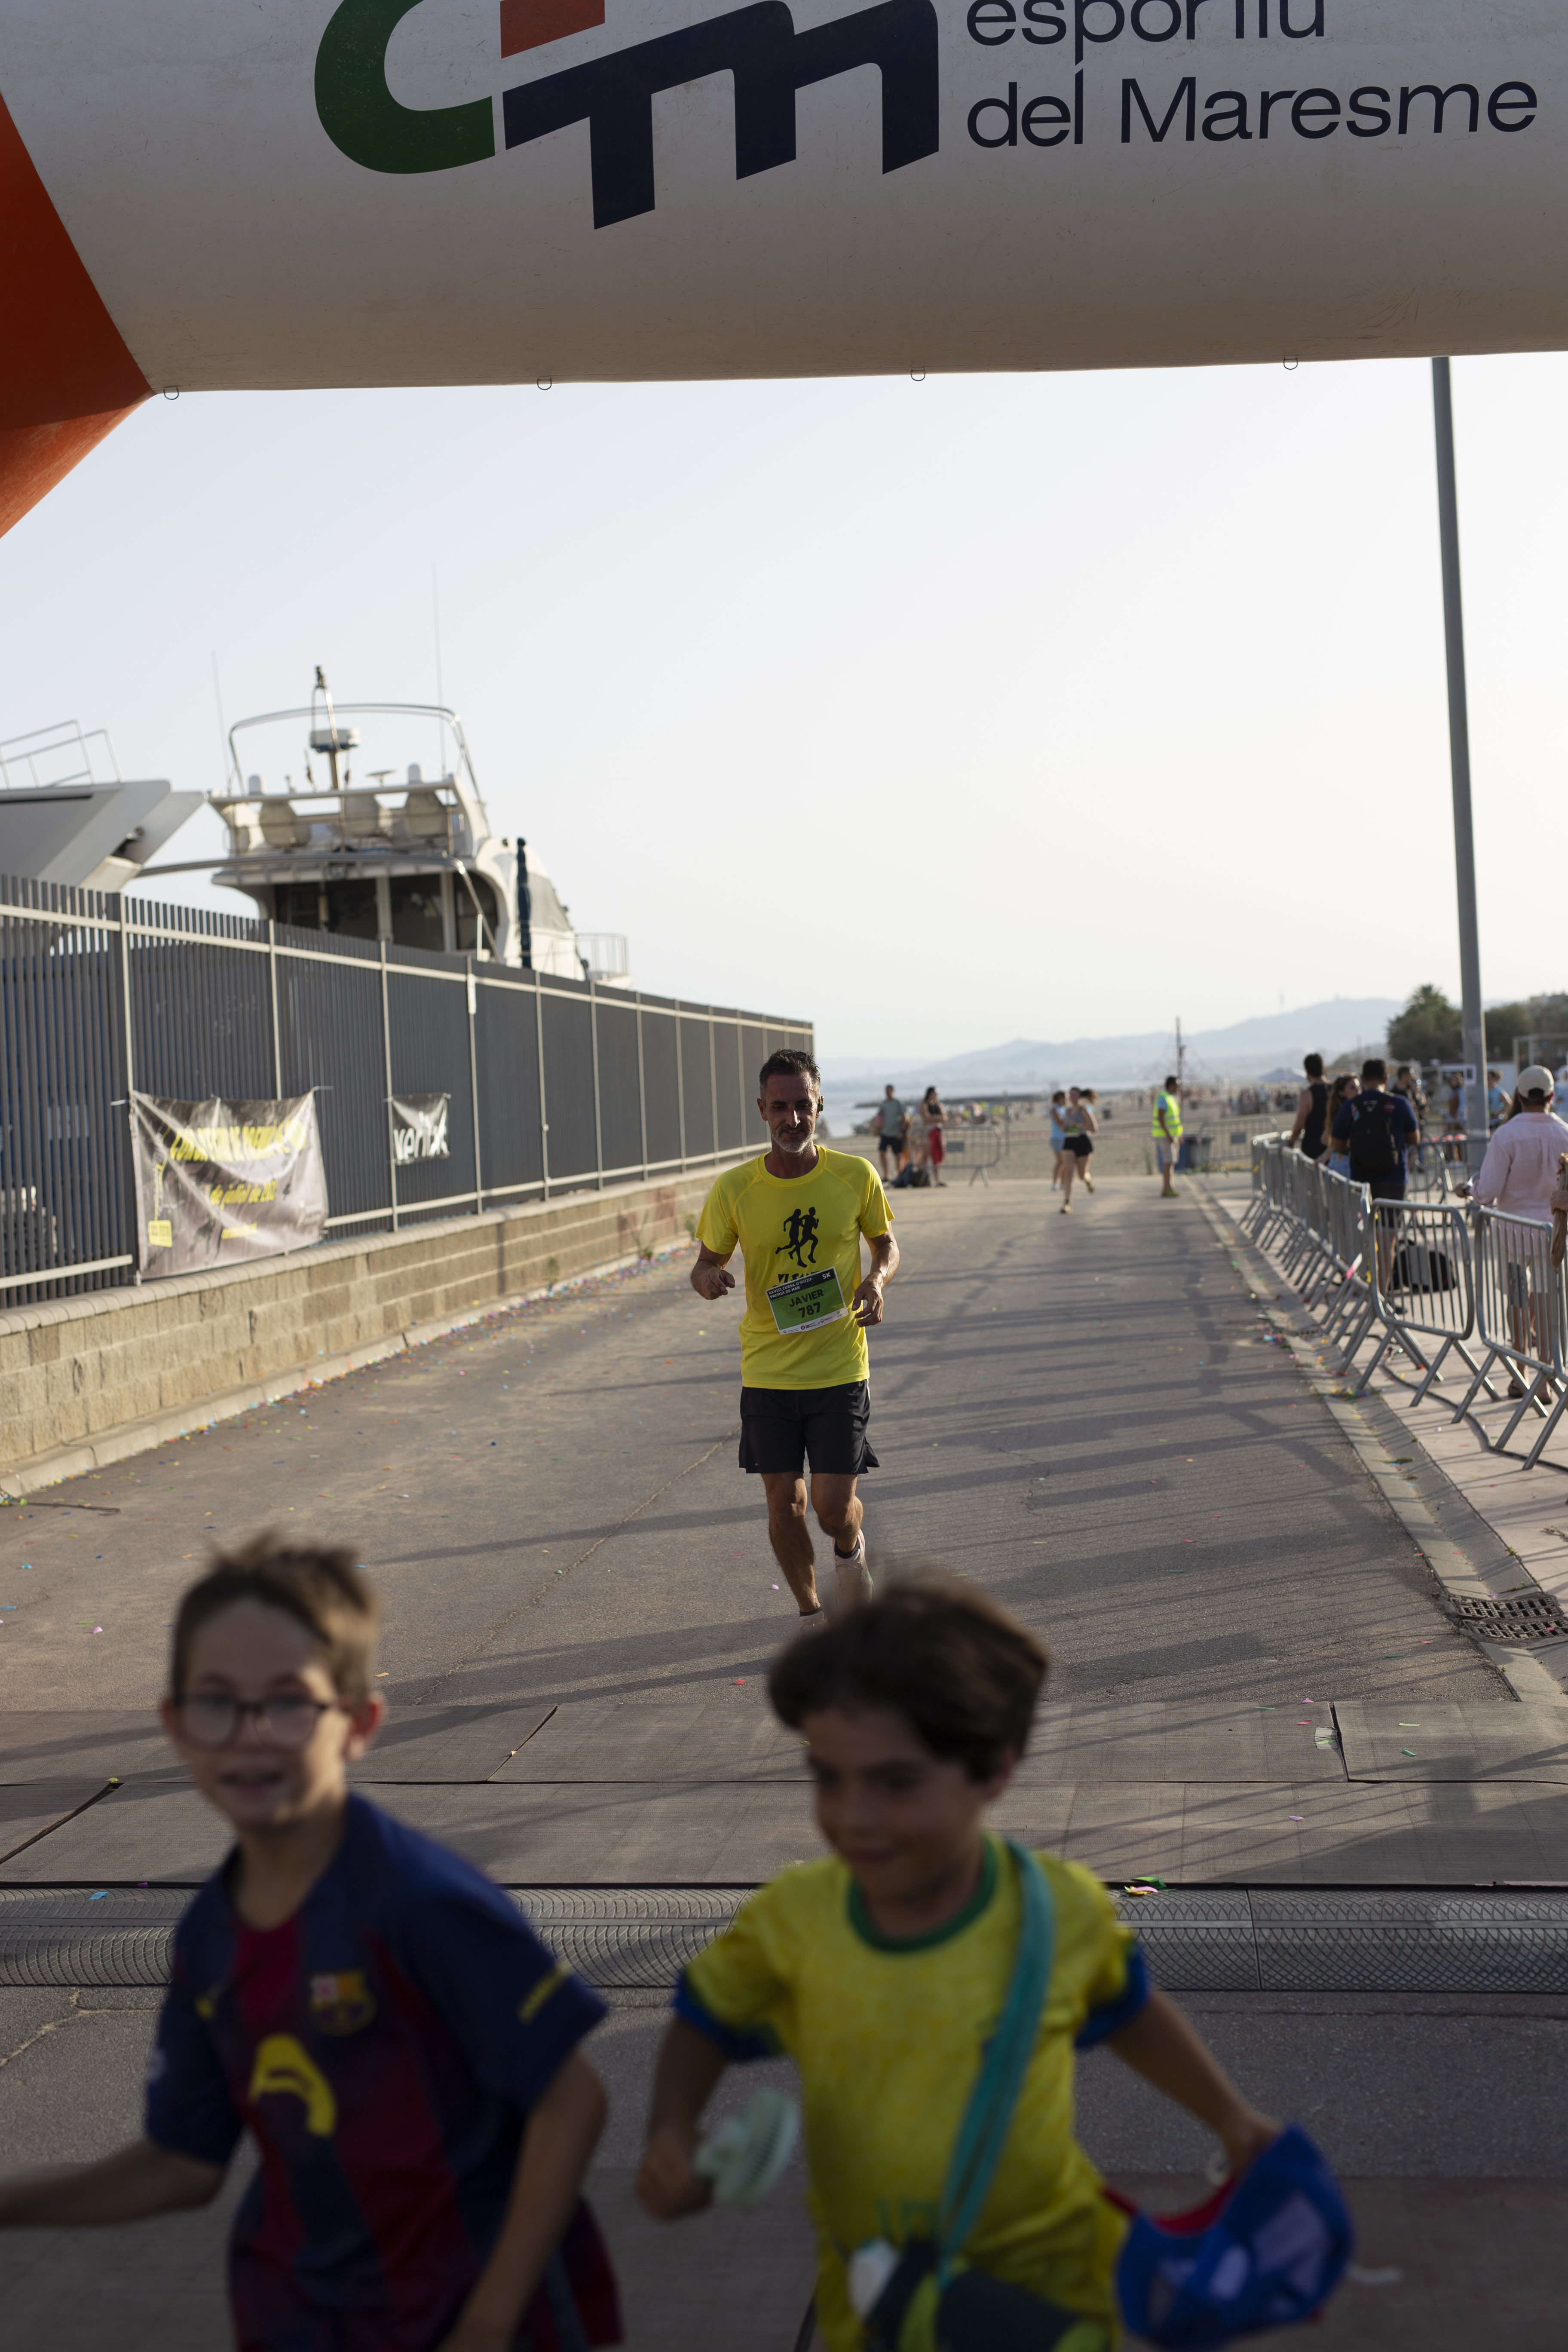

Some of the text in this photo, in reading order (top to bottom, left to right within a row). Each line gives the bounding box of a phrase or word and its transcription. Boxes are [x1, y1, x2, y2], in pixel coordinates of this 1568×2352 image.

[967, 68, 1537, 148] del Maresme
[770, 1290, 785, 1298] PREMIÀ
[789, 1289, 824, 1307] JAVIER
[798, 1302, 821, 1318] 787
